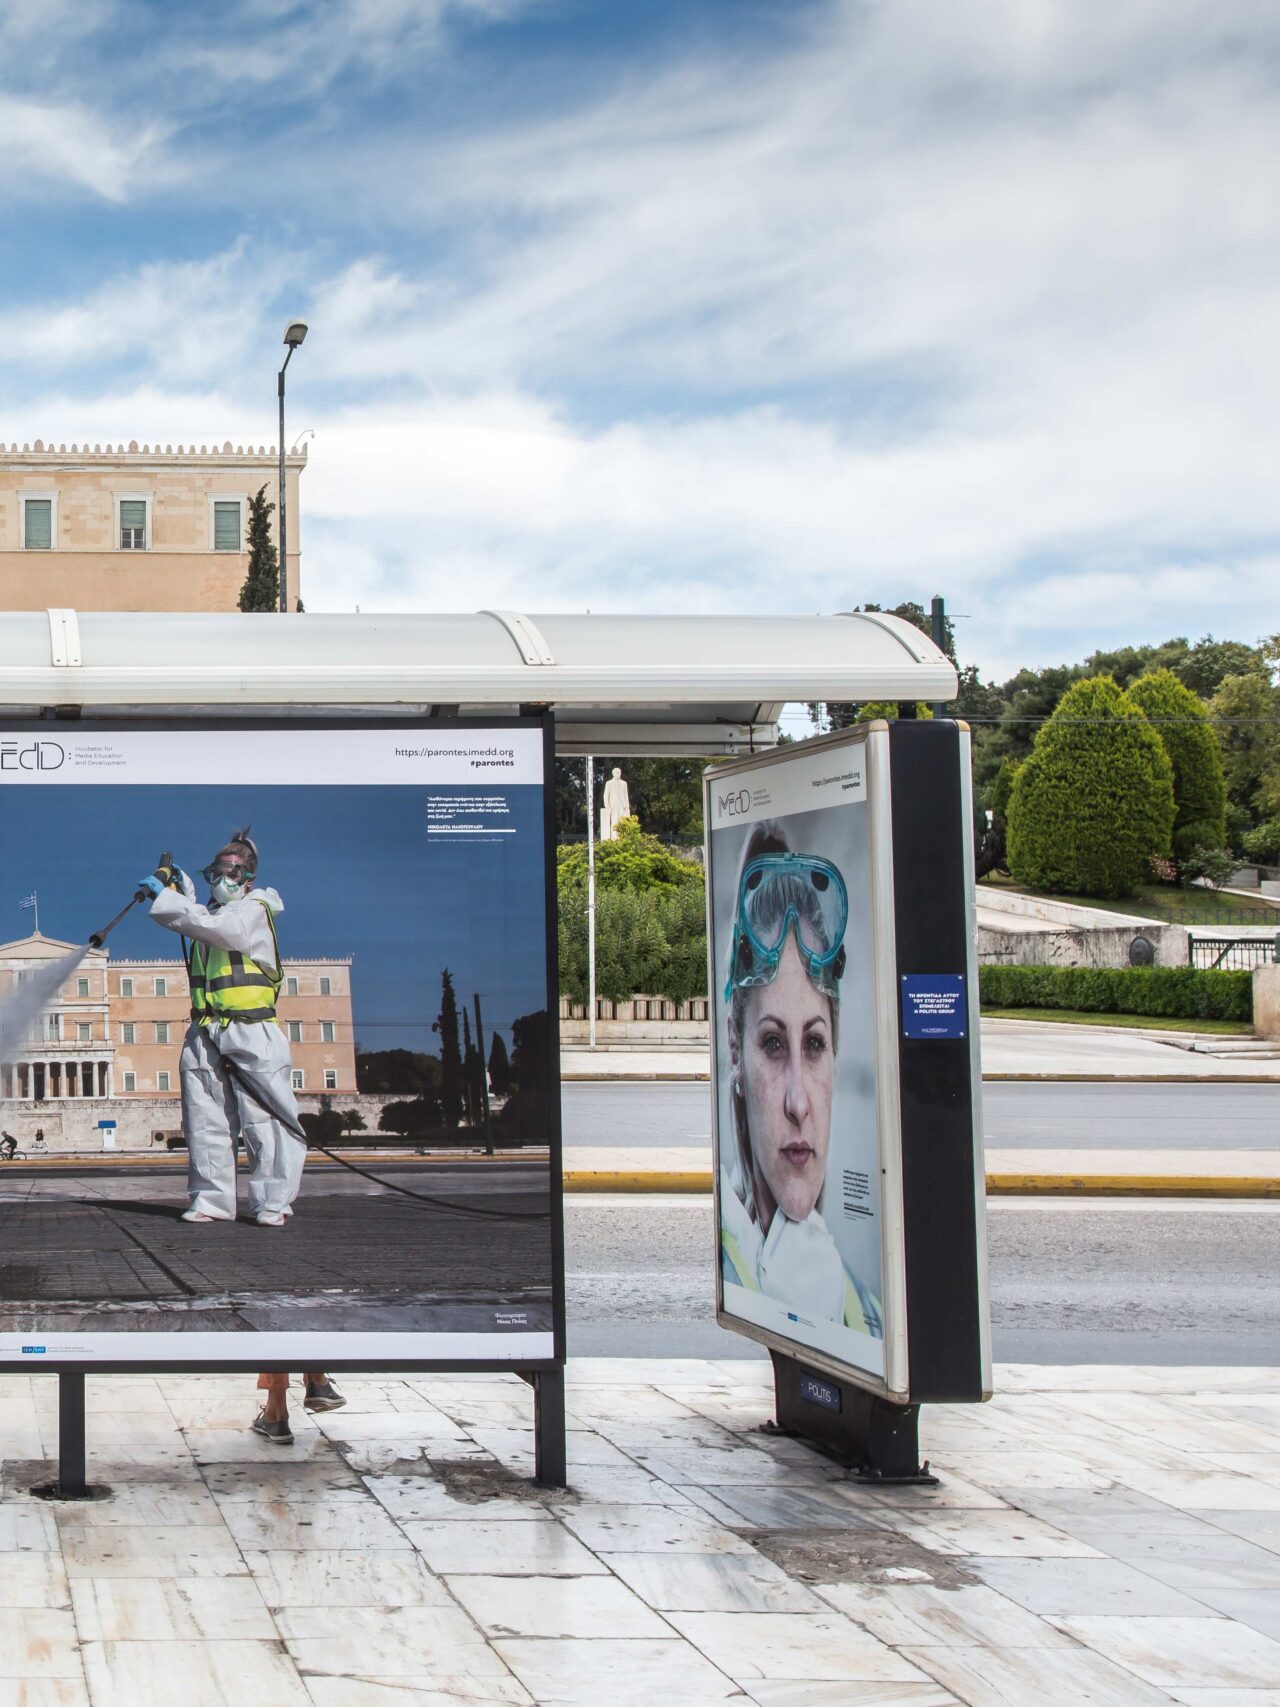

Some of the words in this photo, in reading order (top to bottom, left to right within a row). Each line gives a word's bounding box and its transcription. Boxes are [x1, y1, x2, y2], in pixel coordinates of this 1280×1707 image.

[395, 747, 514, 758] https://parontes.imedd.org
[470, 759, 515, 768] #parontes
[808, 1381, 832, 1402] POLITIS
